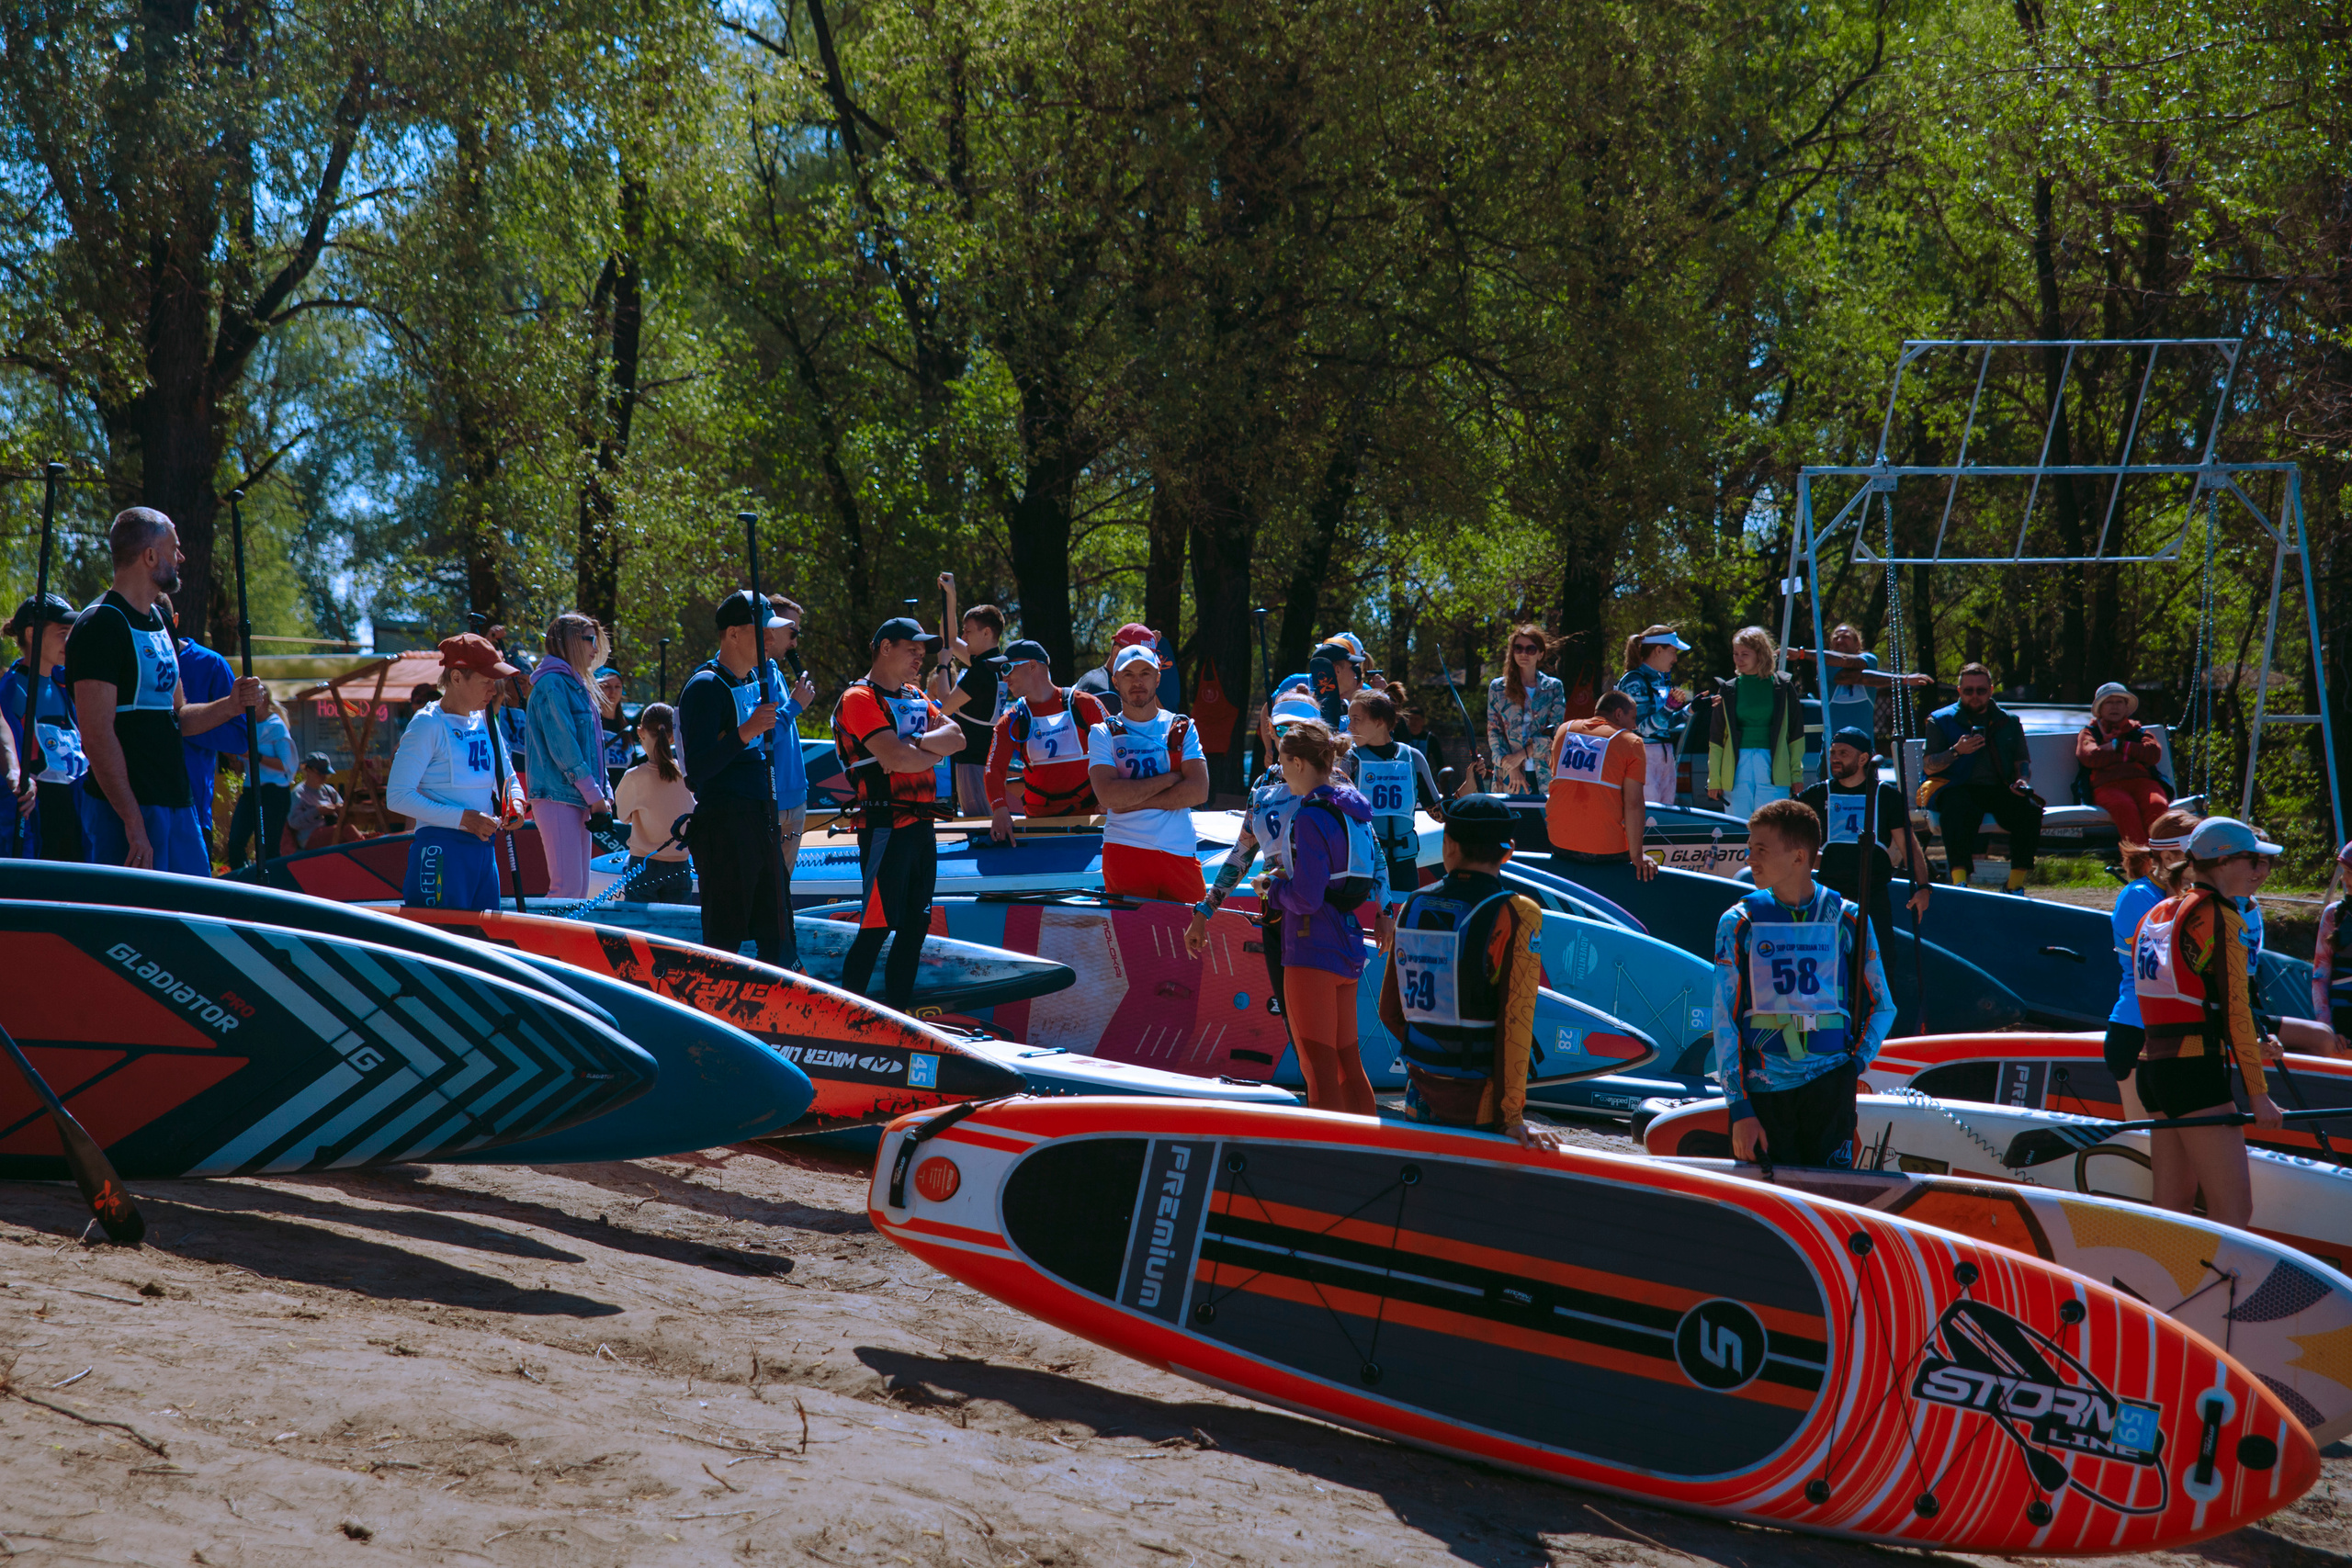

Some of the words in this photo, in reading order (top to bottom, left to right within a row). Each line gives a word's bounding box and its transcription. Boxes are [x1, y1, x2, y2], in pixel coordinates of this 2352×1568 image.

[155, 660, 175, 692] 25
[469, 740, 491, 772] 45
[608, 748, 628, 764] 53
[1045, 739, 1057, 758] 2
[1562, 749, 1597, 772] 404
[1125, 757, 1159, 779] 28
[1373, 784, 1401, 809] 66
[1265, 810, 1281, 840] 6
[1846, 815, 1859, 833] 4
[1771, 957, 1820, 996] 58
[2137, 946, 2159, 980] 56
[220, 990, 256, 1018] PRO
[1405, 969, 1436, 1012] 59
[1690, 1009, 1704, 1028] 66
[1557, 1029, 1573, 1051] 28
[910, 1056, 927, 1083] 45
[2118, 1408, 2143, 1442] 59
